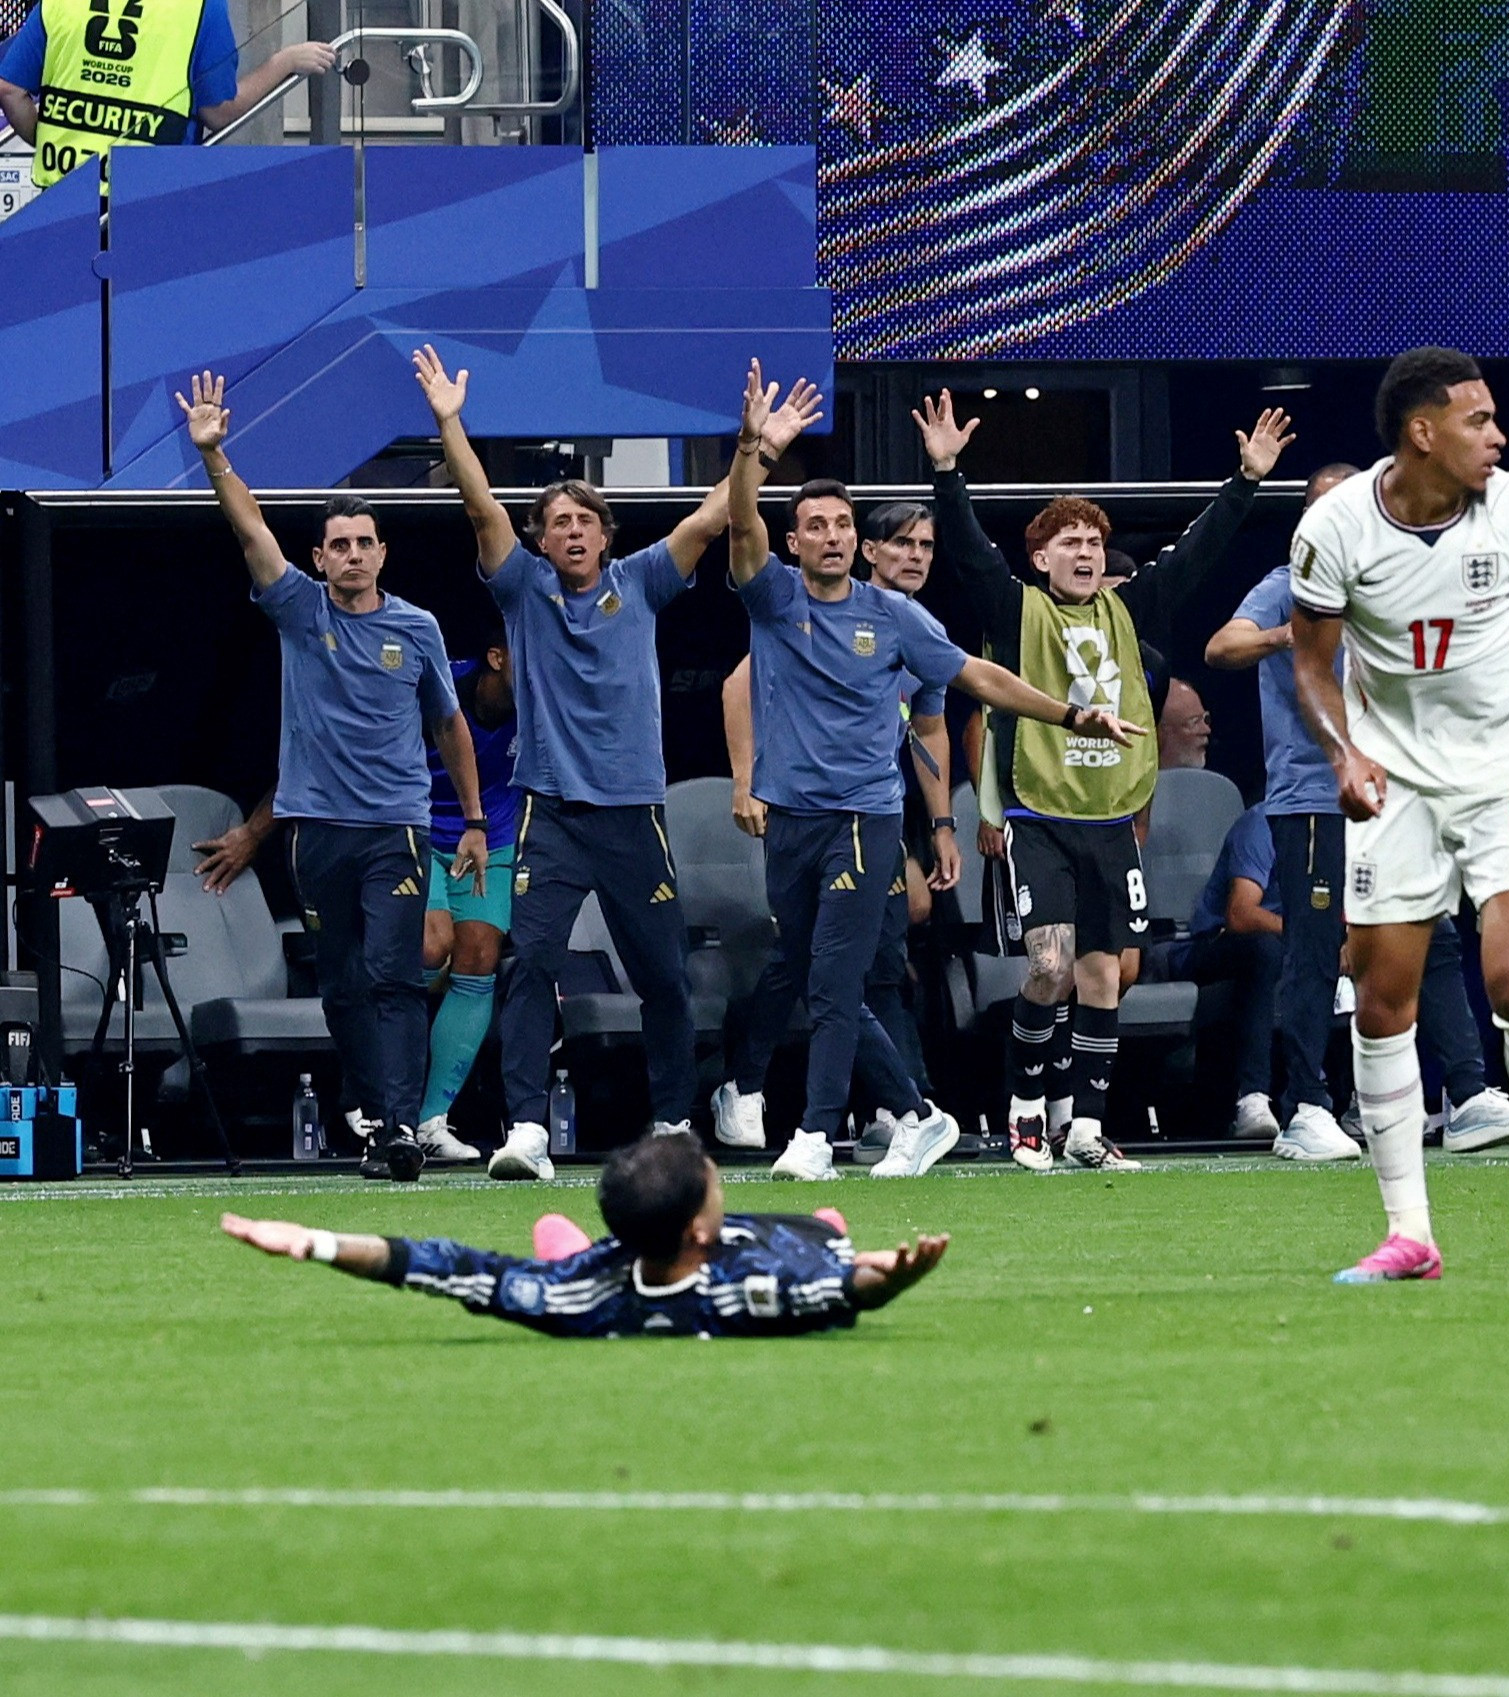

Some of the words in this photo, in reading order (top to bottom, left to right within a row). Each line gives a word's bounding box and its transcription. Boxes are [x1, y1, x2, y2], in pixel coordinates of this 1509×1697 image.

[98, 40, 123, 54] FIFA
[82, 59, 114, 71] WORLD
[115, 64, 134, 74] CUP
[80, 68, 131, 88] 2026
[43, 93, 165, 138] SECURITY
[1408, 618, 1454, 670] 17
[1066, 736, 1110, 749] WORLD
[1126, 867, 1147, 911] 8
